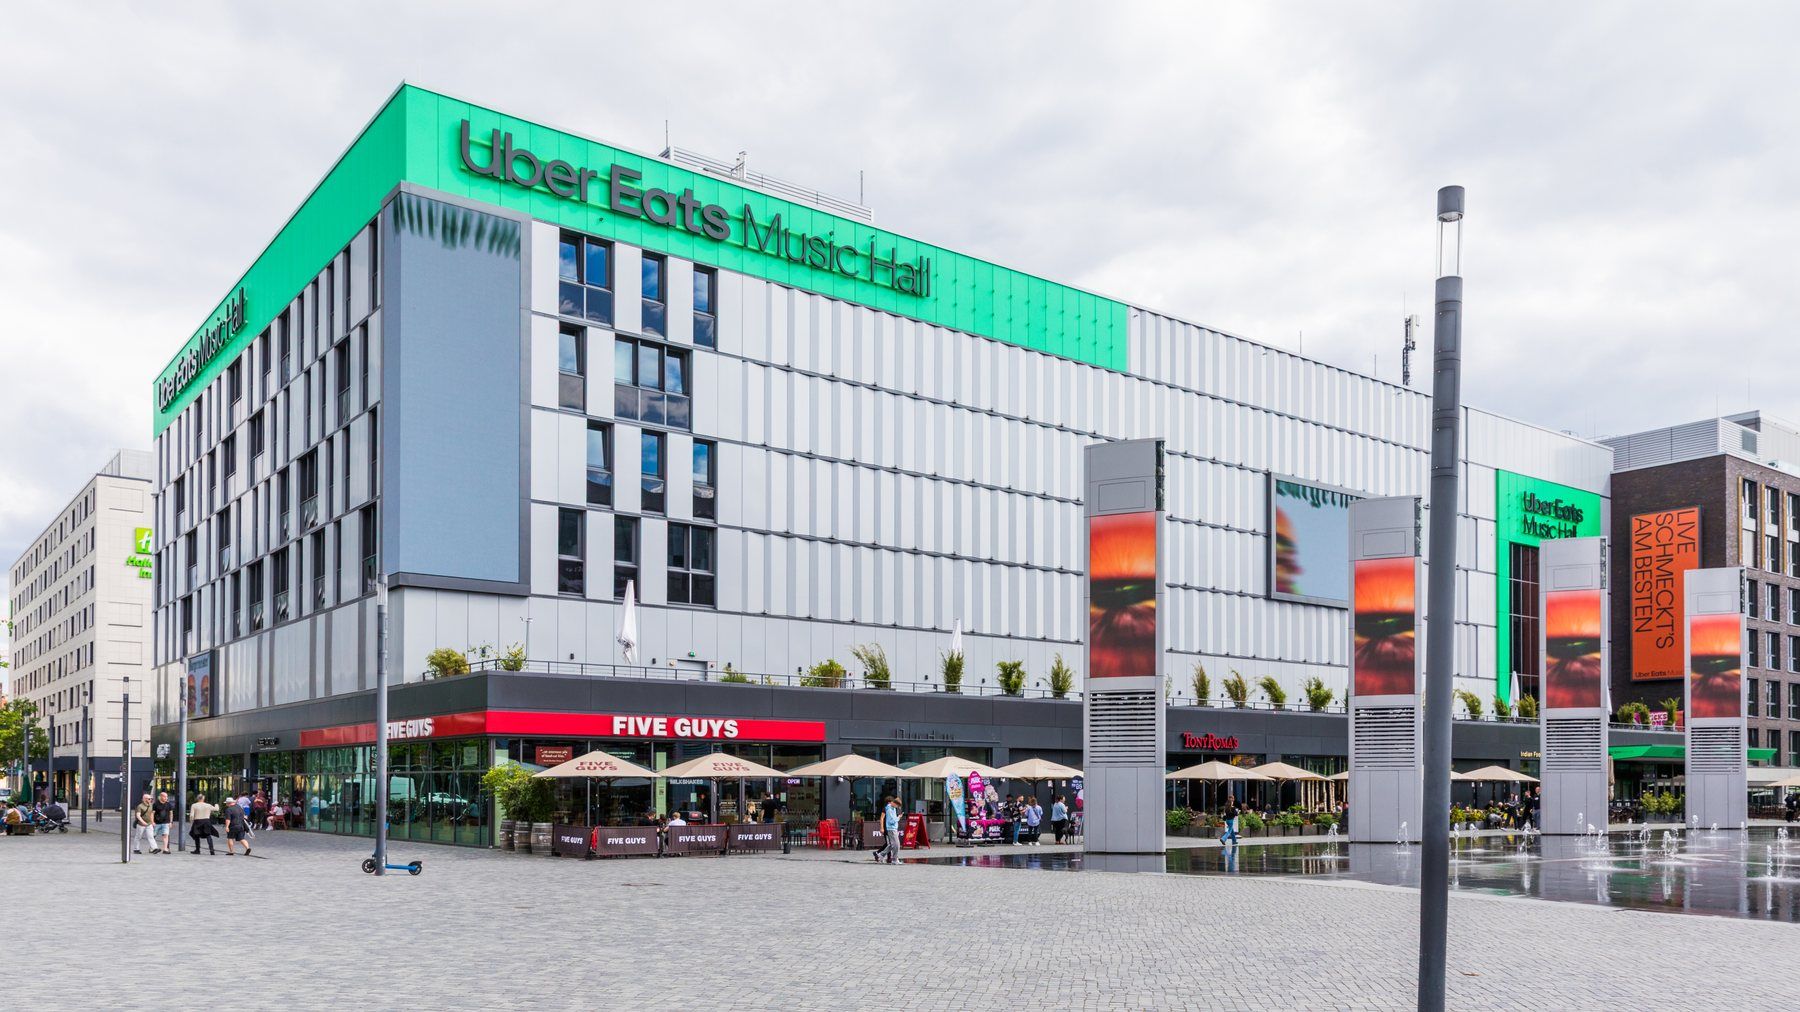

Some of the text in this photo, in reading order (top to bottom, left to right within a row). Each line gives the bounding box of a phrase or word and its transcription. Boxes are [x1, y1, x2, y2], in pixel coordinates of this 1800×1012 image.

[460, 118, 598, 202] Uber
[610, 163, 731, 241] Eats
[743, 203, 859, 278] Music
[870, 240, 931, 298] Hall
[158, 371, 178, 411] Uber
[199, 318, 226, 368] Music
[226, 287, 244, 340] Hall
[1523, 490, 1583, 524] Uber Eats
[1523, 513, 1577, 540] Music Hall
[1677, 510, 1695, 554] LIVE
[1635, 517, 1652, 632] AM BESTEN
[1656, 513, 1674, 649] SCHMECKT'S
[406, 718, 433, 737] GUYS
[613, 716, 739, 738] FIVE GUYS
[570, 836, 583, 844] GUYS
